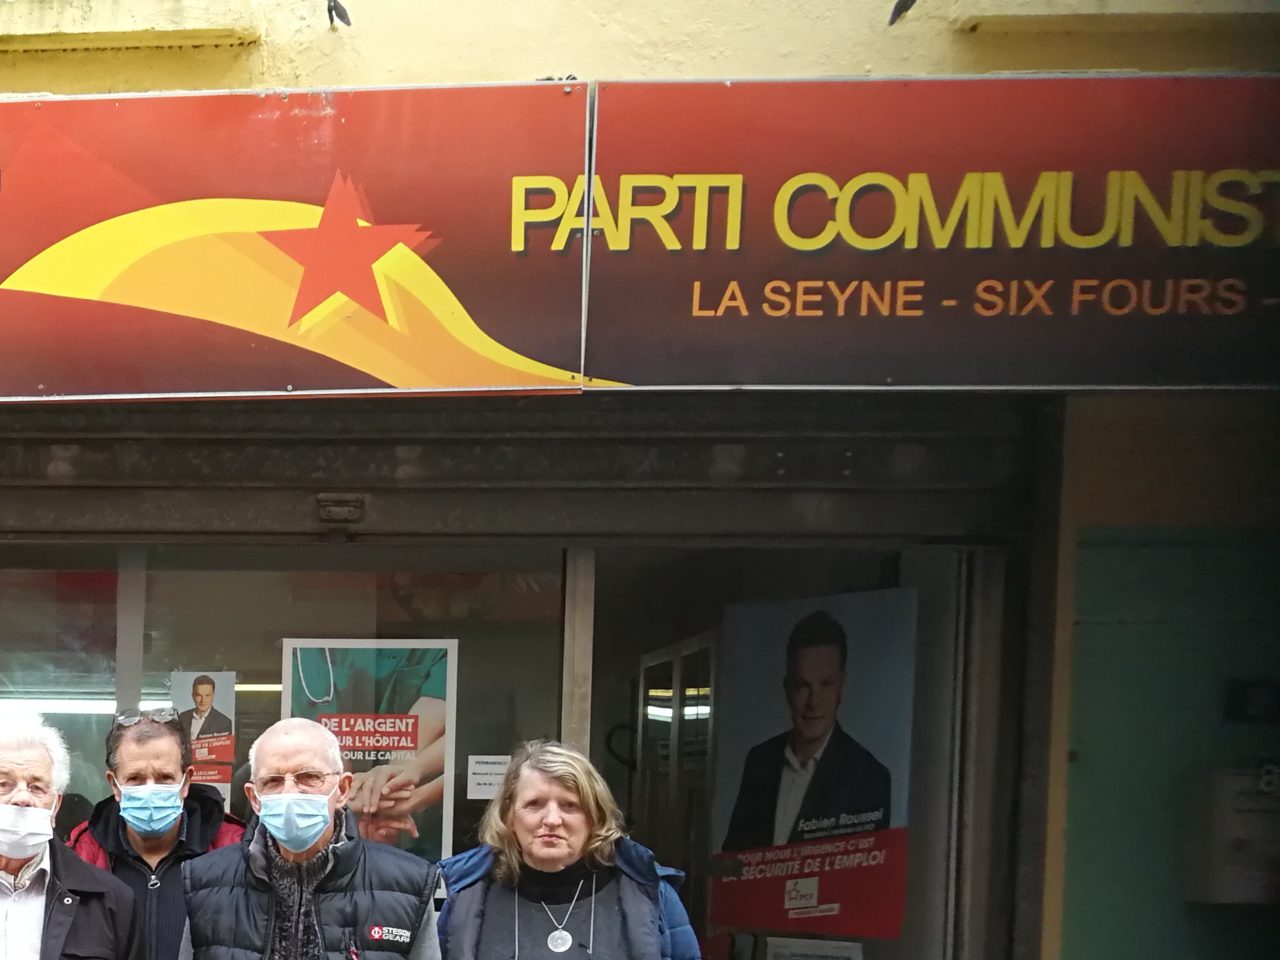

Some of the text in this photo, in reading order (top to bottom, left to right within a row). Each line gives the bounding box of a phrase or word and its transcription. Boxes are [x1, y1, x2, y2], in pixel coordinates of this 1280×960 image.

[511, 174, 743, 251] PARTI
[692, 280, 749, 316] LA
[762, 280, 924, 317] SEYNE
[974, 278, 1055, 316] SIX
[1070, 278, 1246, 316] FOURS
[321, 718, 414, 732] DE L'ARGENT
[355, 733, 415, 747] L'HÔPITAL
[342, 751, 416, 760] OUR LE CAPITAL
[798, 808, 884, 831] Fabien Roussel
[765, 848, 791, 862] NOUS
[793, 841, 846, 858] L'URGENCE
[847, 837, 875, 850] C'EST
[741, 849, 886, 881] SÉCURITÉ DE L'EMPLOI
